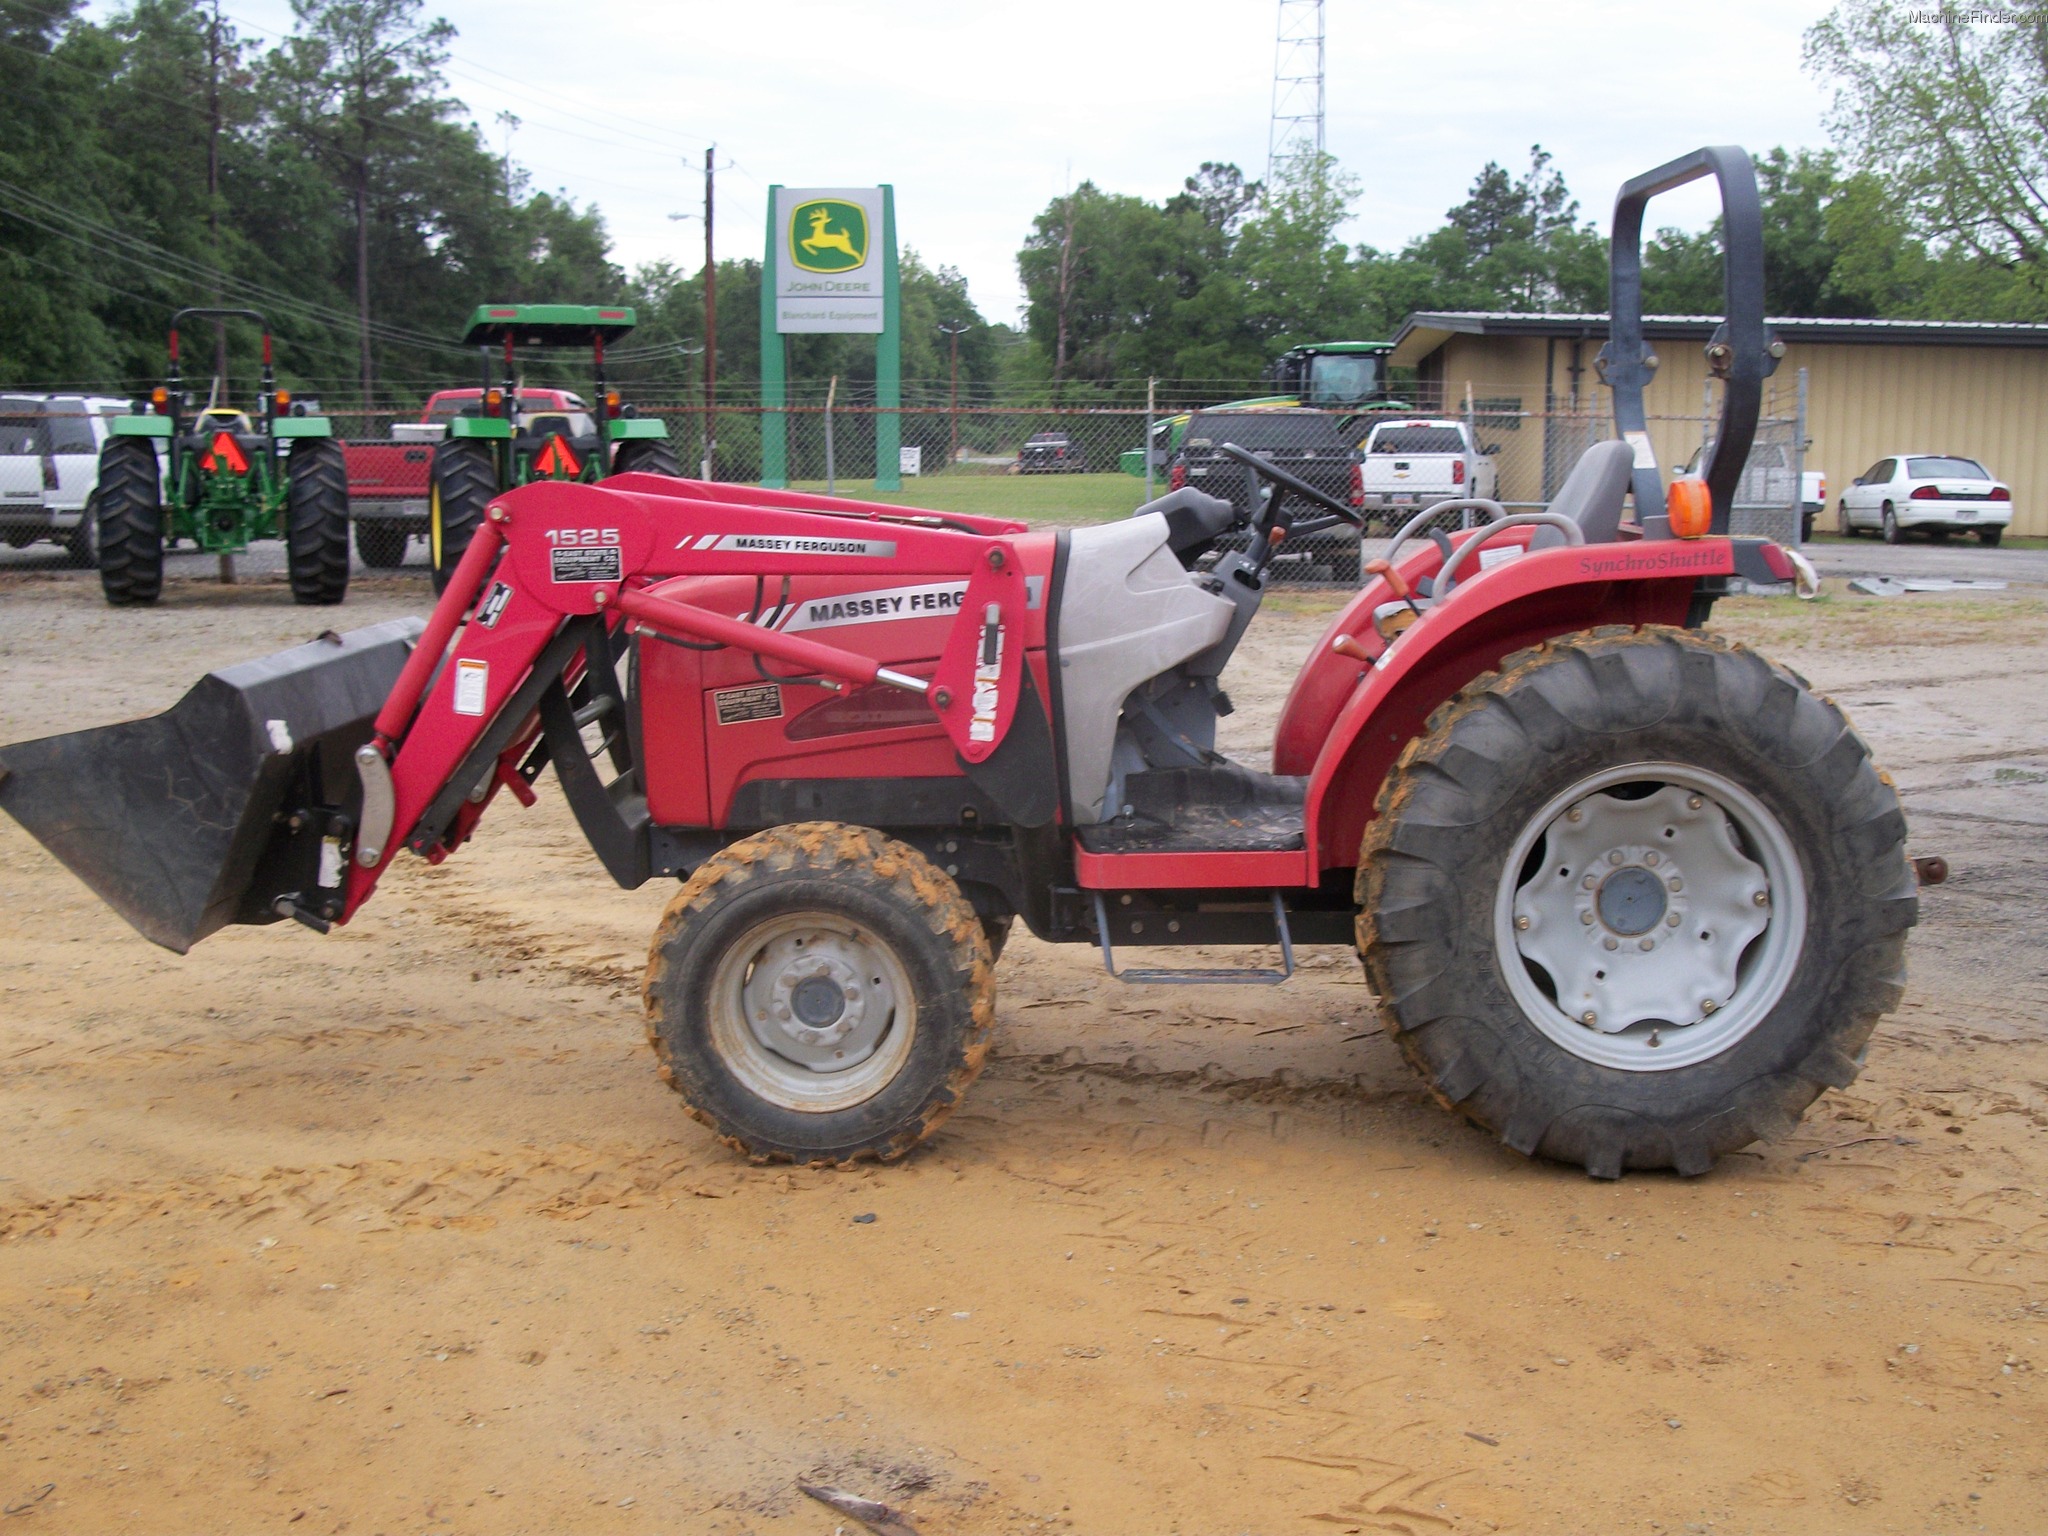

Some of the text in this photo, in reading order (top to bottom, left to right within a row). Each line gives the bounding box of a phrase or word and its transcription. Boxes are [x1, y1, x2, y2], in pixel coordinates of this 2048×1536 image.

[787, 281, 870, 292] JOHN DEERE
[829, 311, 877, 321] Equipment
[545, 529, 620, 545] 1525
[736, 538, 866, 554] MASSEY FERGUSON
[1580, 549, 1726, 577] SynchroShuttle
[809, 596, 903, 623] MASSEY
